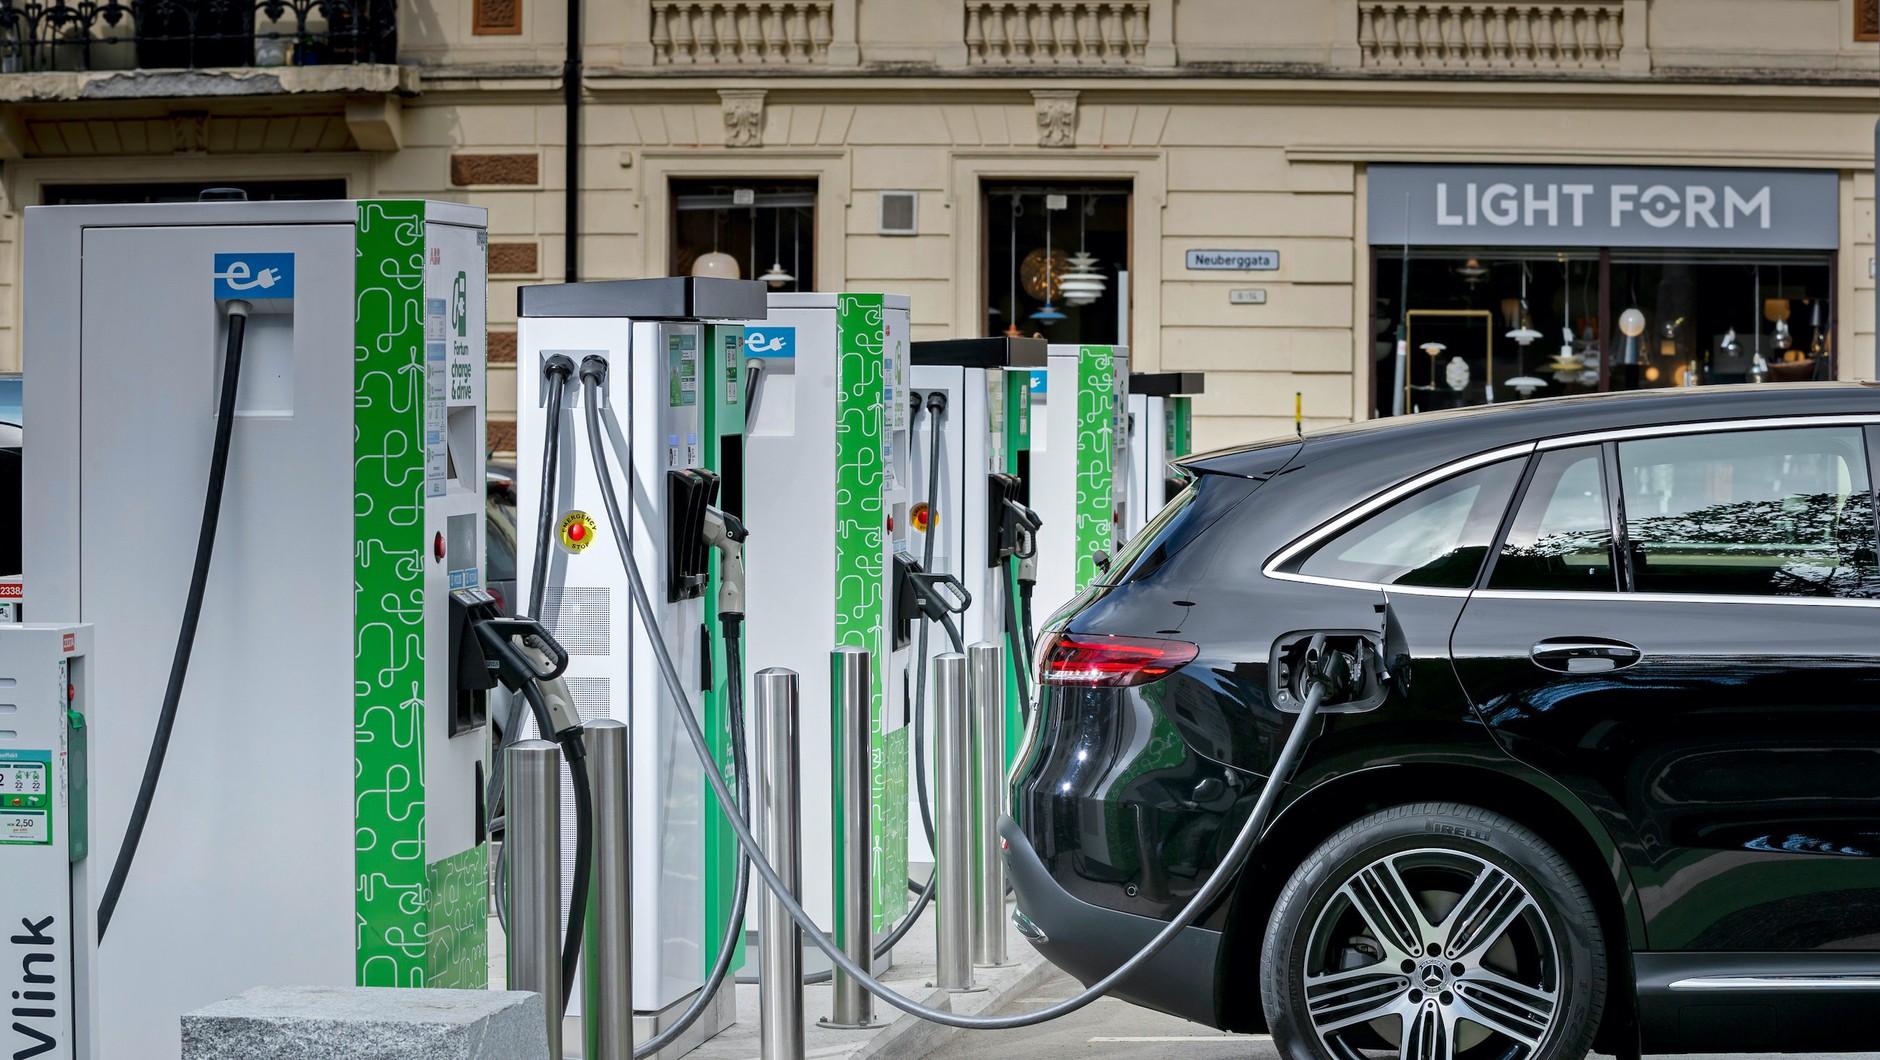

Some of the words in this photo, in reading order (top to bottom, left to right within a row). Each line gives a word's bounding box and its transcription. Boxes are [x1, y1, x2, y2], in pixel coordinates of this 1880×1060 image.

[1437, 183, 1594, 226] LIGHT
[1611, 184, 1771, 229] FORM
[1195, 254, 1270, 268] Neuberggata
[454, 340, 469, 355] Fortum
[451, 357, 471, 383] charge
[457, 380, 471, 400] drive
[562, 513, 597, 533] EMERGENCY
[15, 818, 34, 828] 2,50
